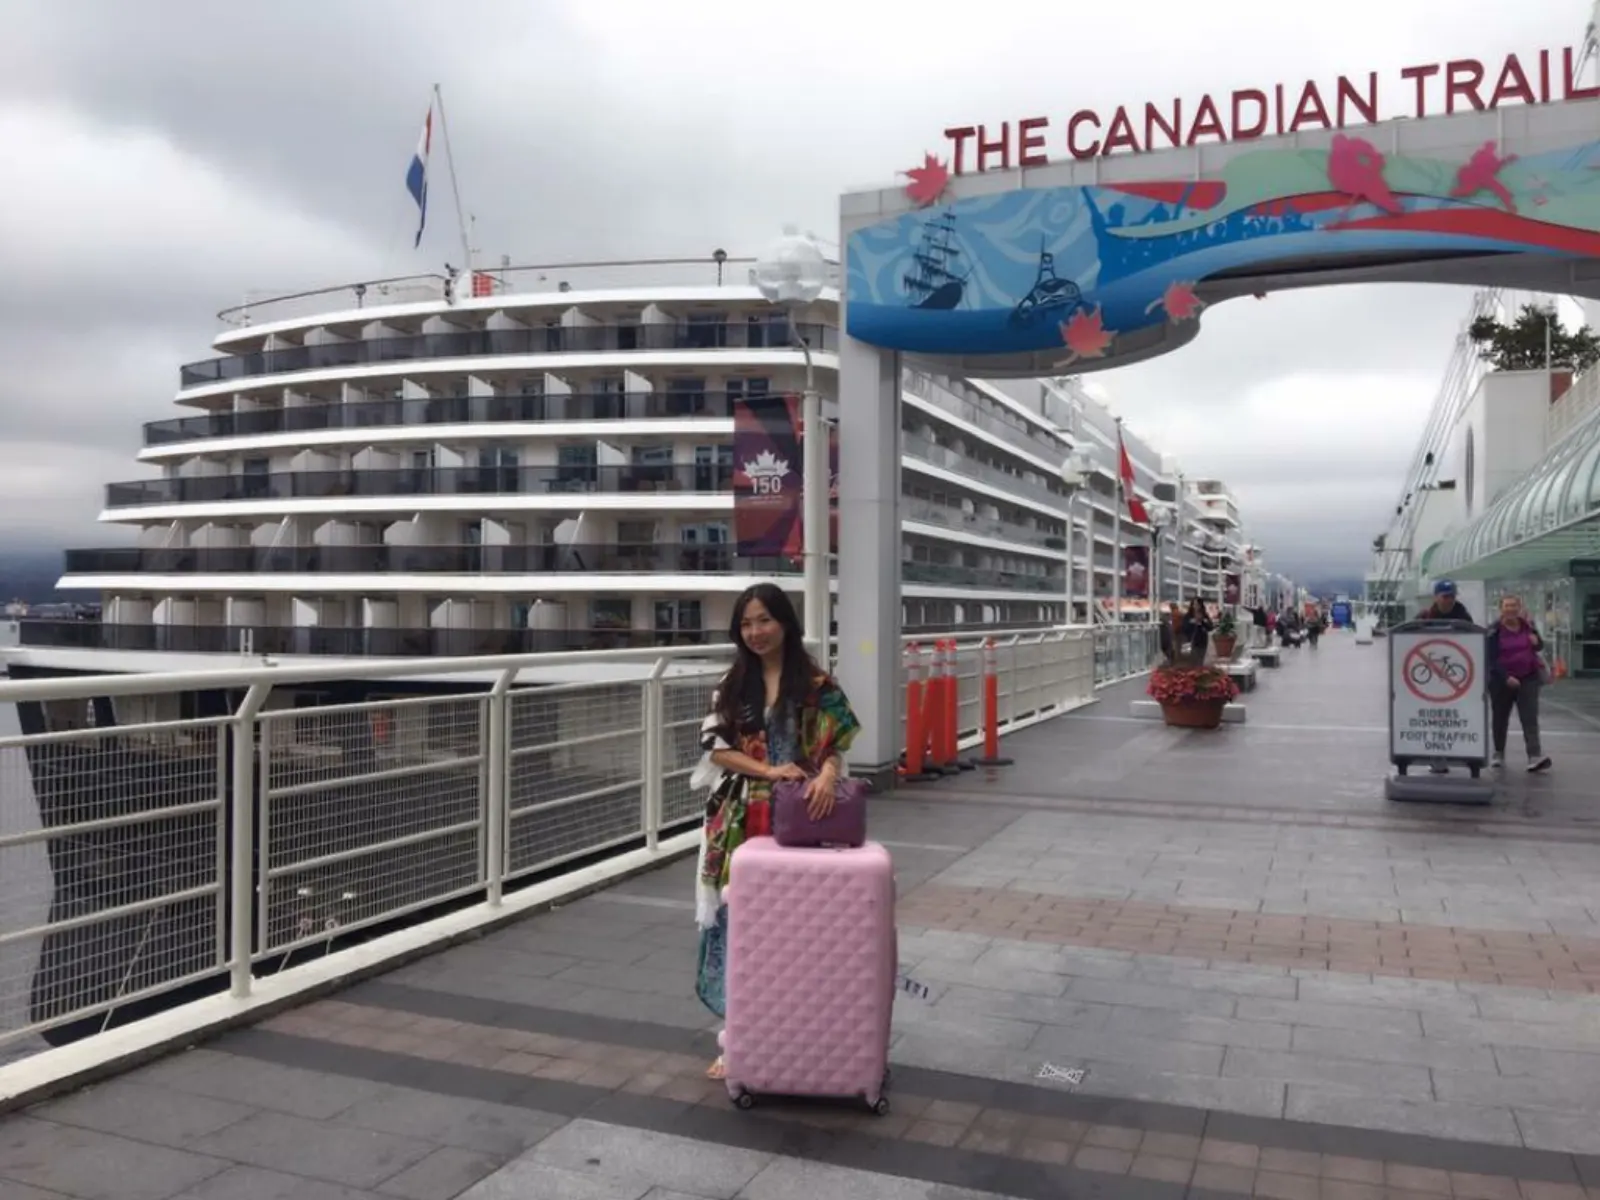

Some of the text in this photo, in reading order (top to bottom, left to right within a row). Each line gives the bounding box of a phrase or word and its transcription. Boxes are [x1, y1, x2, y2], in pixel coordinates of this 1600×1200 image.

[944, 47, 1600, 176] THE CANADIAN TRAIL
[751, 476, 782, 495] 150
[1418, 708, 1460, 718] RIDERS
[1409, 718, 1468, 728] DISMOUNT
[1400, 731, 1479, 742] FOOT TRAFFIC
[1424, 741, 1454, 751] ONLY
